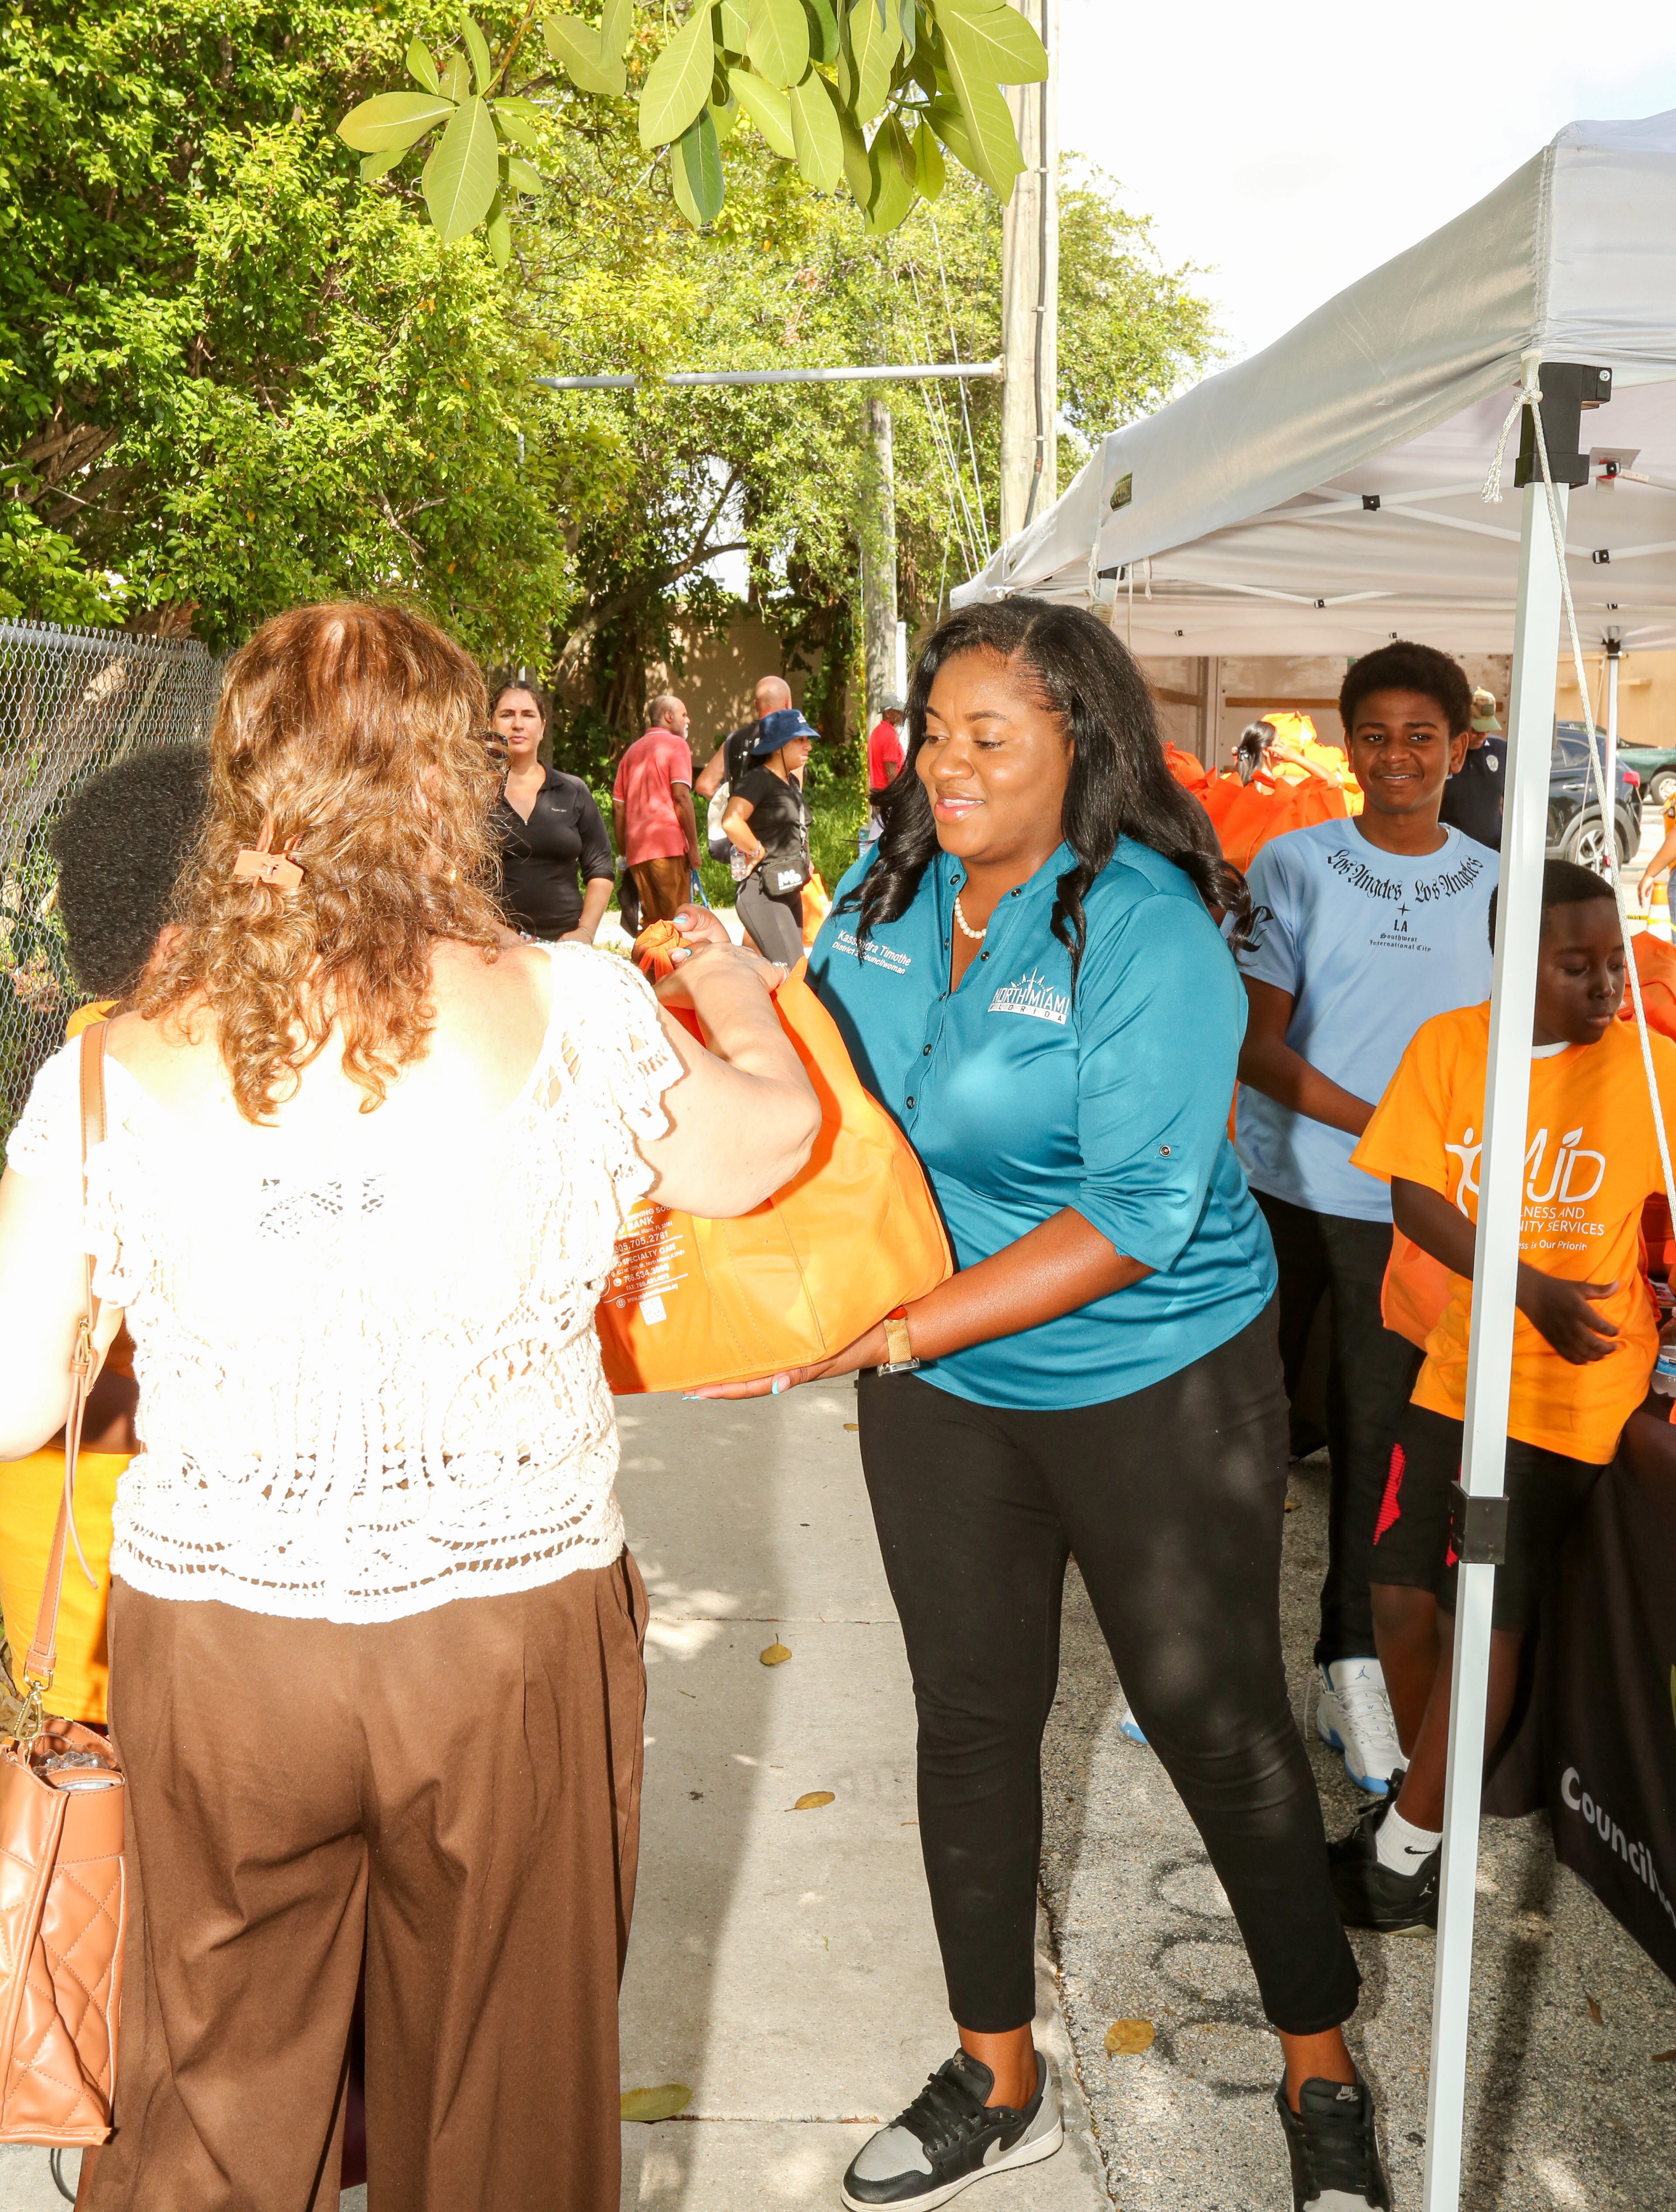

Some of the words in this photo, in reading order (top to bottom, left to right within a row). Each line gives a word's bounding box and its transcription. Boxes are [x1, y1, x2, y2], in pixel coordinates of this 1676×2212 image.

[1327, 849, 1357, 875] Los
[1348, 864, 1402, 901] Angeles
[1415, 879, 1440, 903] Los
[1439, 855, 1484, 897] Angeles
[1394, 919, 1408, 933] LA
[1369, 940, 1415, 950] International
[1380, 933, 1417, 942] Southwest
[832, 941, 855, 955] District
[879, 945, 911, 966] Timothe
[992, 987, 1027, 1004] NORTH
[1028, 989, 1070, 1015] MIAMI
[990, 1004, 1062, 1021] FLORIDA
[1521, 1206, 1556, 1219] NESS
[1558, 1207, 1585, 1219] AND
[627, 1216, 655, 1232] BANK
[1546, 1220, 1604, 1236] SERVICES
[1539, 1240, 1556, 1249] Our
[622, 1249, 657, 1265] SPECIALTY
[659, 1243, 676, 1254] CARE
